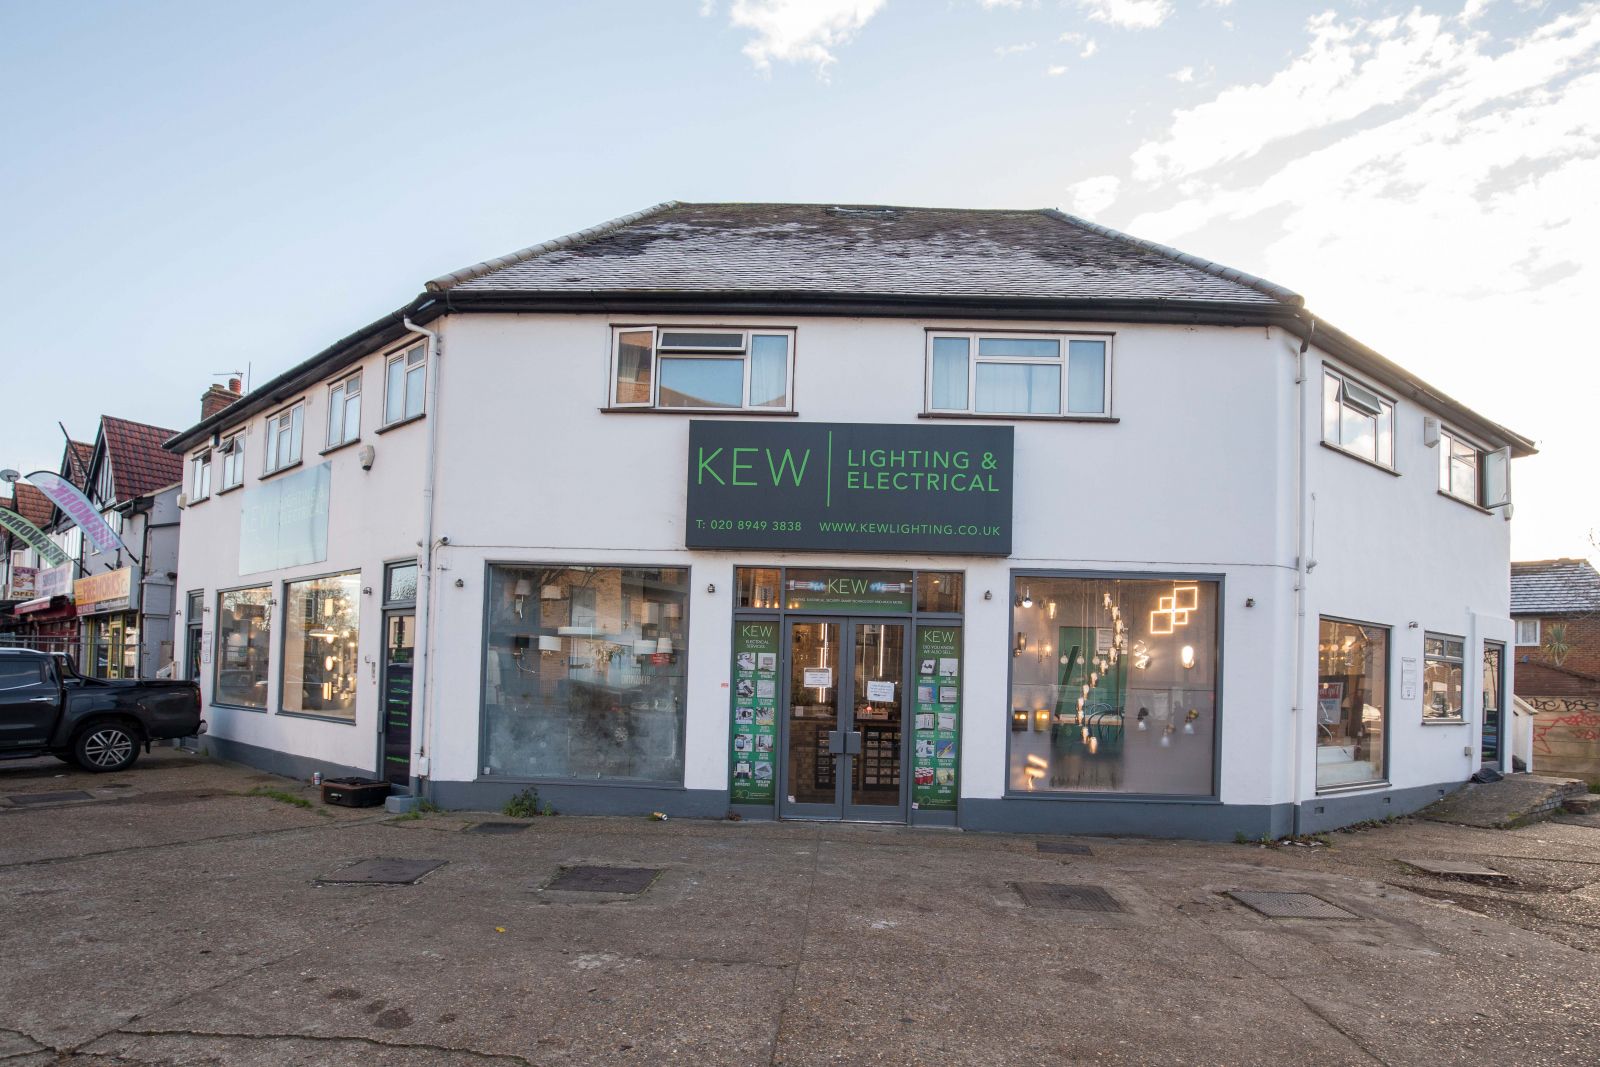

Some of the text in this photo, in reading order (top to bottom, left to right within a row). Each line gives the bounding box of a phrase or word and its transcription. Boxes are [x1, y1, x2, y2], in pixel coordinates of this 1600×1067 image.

[698, 447, 811, 487] KEW
[847, 449, 998, 470] LIGHTING &
[847, 471, 1000, 492] ELECTRICAL
[696, 519, 802, 532] T: 020 8949 3838
[819, 522, 1000, 537] WWW.KEWLIGHTING.CO.UK
[828, 579, 869, 595] KEW
[742, 625, 773, 637] KEW
[924, 630, 955, 643] KEW
